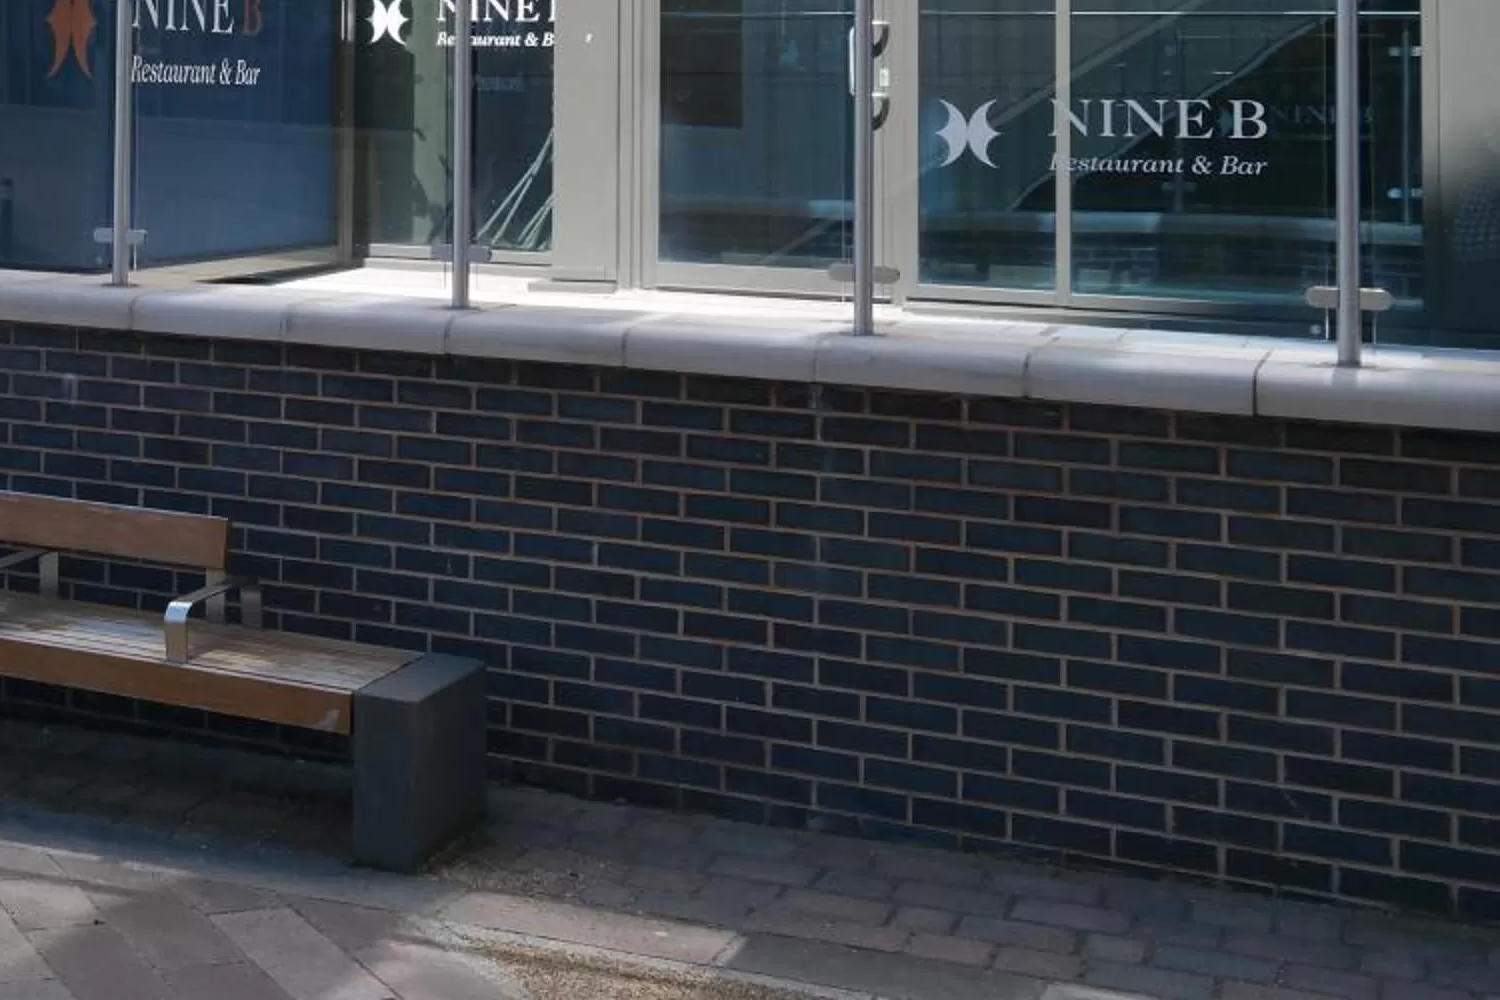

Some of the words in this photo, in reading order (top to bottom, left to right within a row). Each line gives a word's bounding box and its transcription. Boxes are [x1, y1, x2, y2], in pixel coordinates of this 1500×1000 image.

[435, 31, 521, 47] Reaurant
[524, 31, 539, 47] &
[131, 55, 217, 84] Restaurant
[219, 57, 232, 85] &
[235, 59, 261, 85] Bar
[1049, 99, 1213, 138] NINE
[1228, 99, 1268, 139] B
[1191, 155, 1212, 174] &
[1220, 155, 1269, 175] Bar
